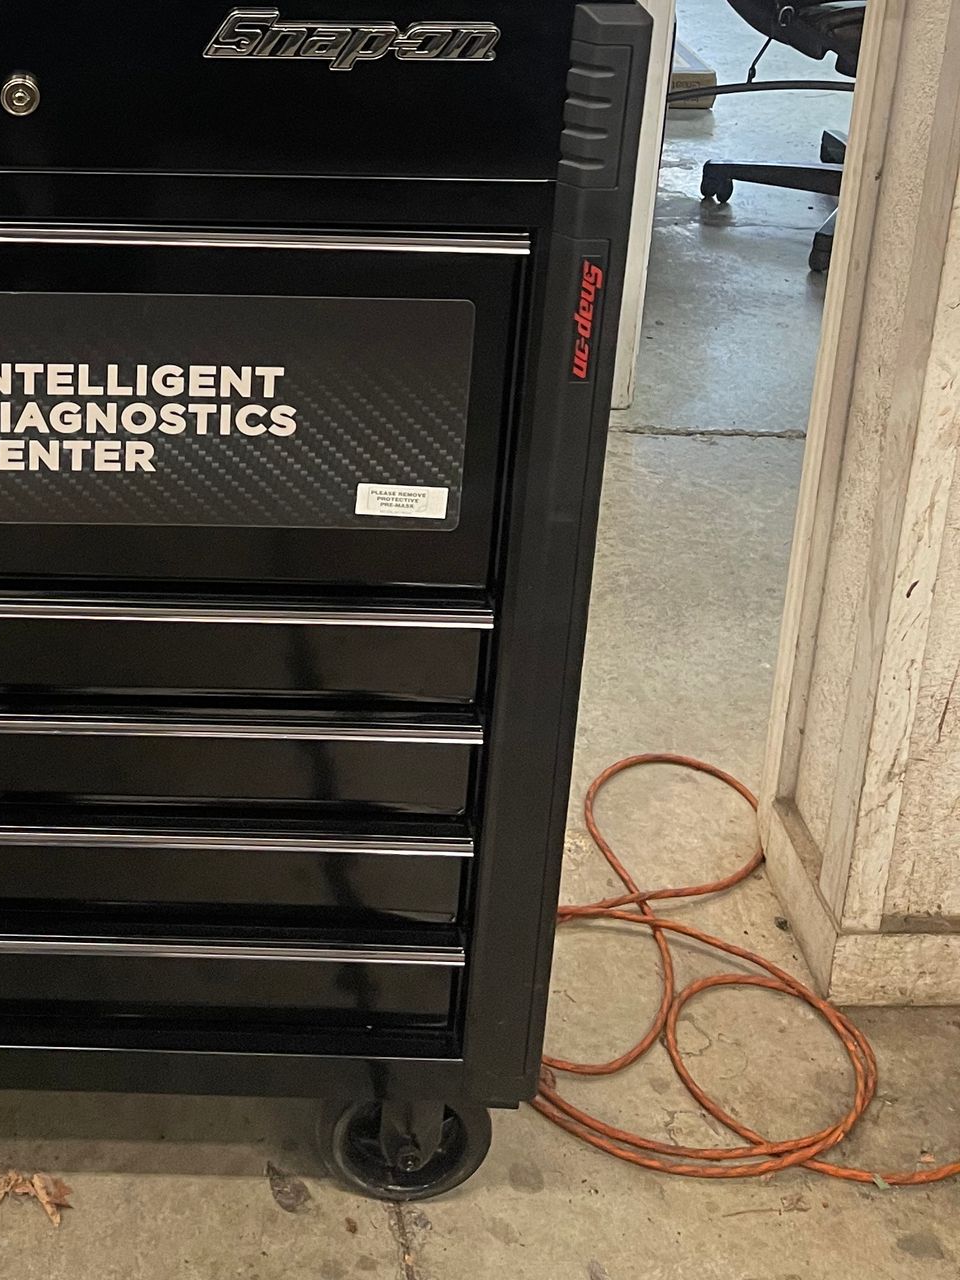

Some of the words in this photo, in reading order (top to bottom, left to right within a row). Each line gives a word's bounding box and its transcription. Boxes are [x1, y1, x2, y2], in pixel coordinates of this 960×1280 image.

[202, 6, 502, 71] Snap-on
[572, 259, 604, 379] Snap-on
[370, 489, 396, 497] PLEASE
